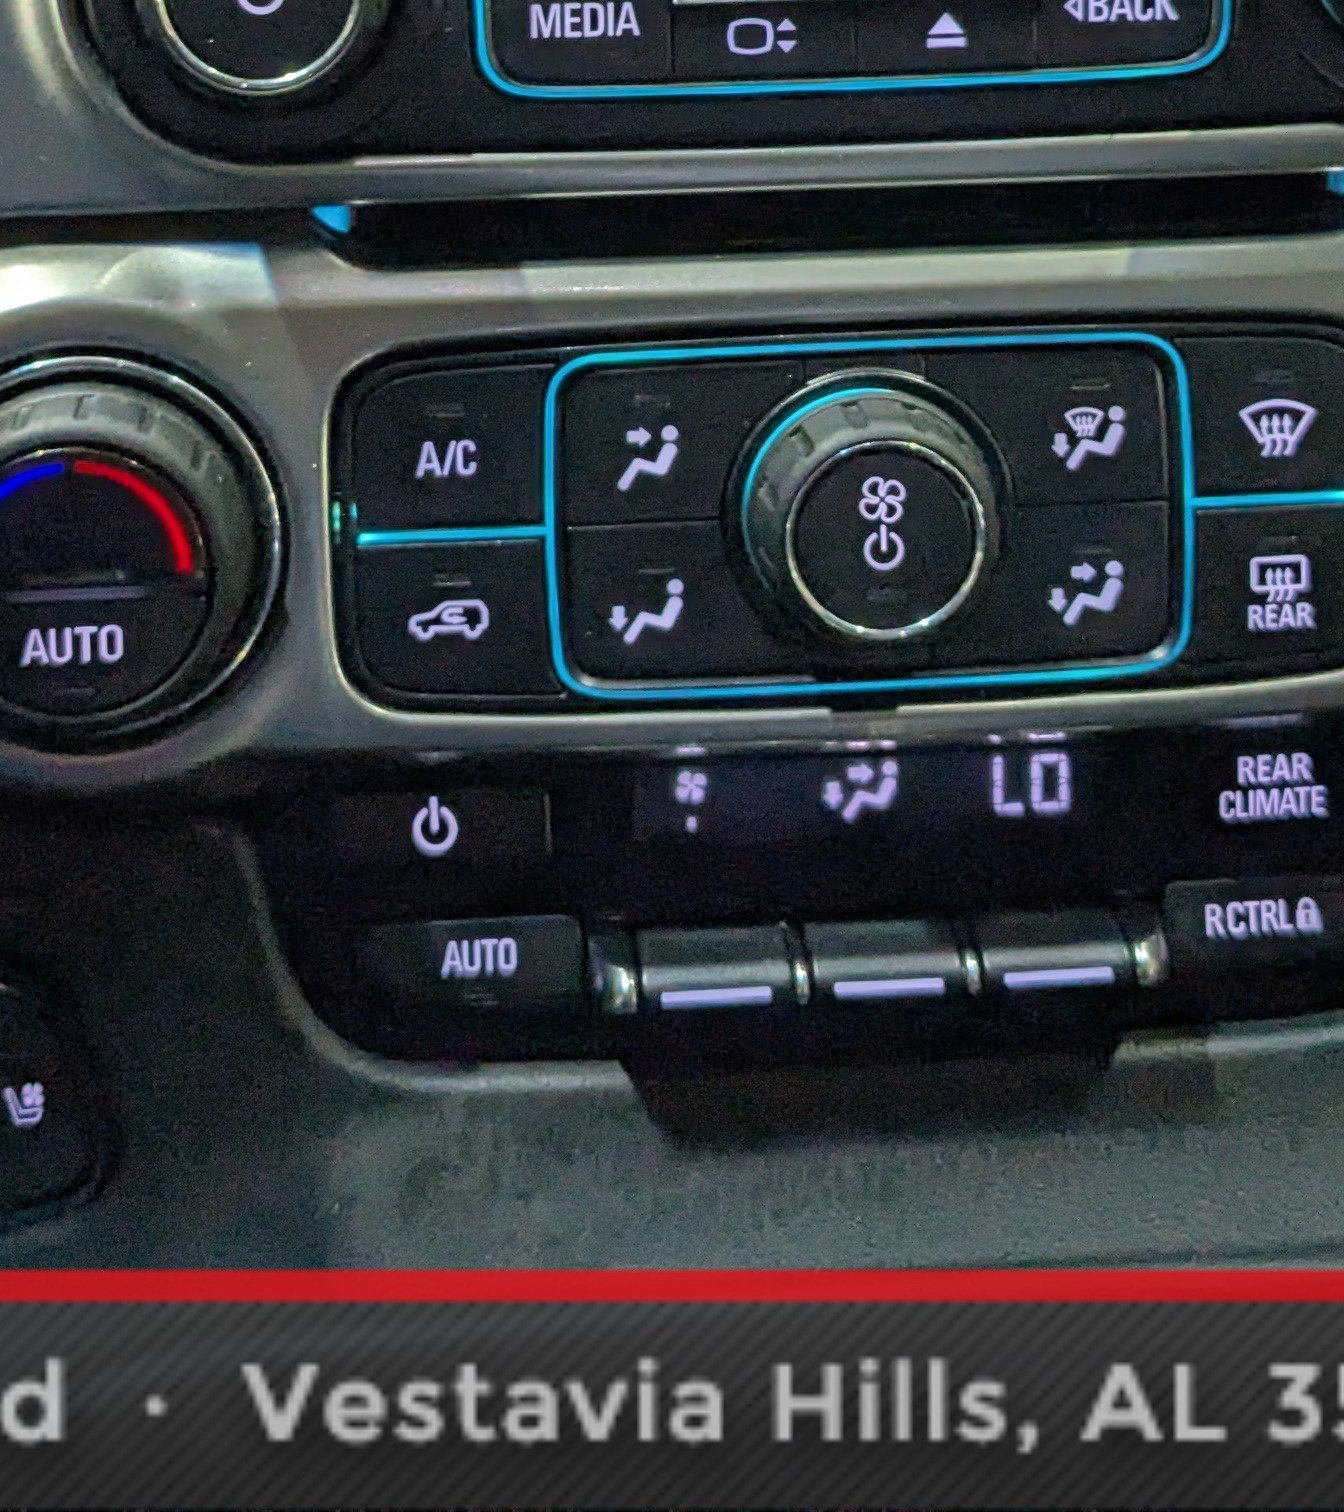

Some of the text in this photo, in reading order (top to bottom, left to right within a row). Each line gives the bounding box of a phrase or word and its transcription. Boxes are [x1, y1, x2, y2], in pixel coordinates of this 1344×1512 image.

[530, 2, 640, 38] MEDIA
[416, 440, 477, 478] A/C
[1248, 600, 1314, 630] REAR
[22, 625, 123, 665] AUTO
[1238, 753, 1312, 784] REAR
[1220, 782, 1326, 820] CLIMATE
[1205, 899, 1293, 937] RCTRL
[441, 938, 517, 977] AUTO
